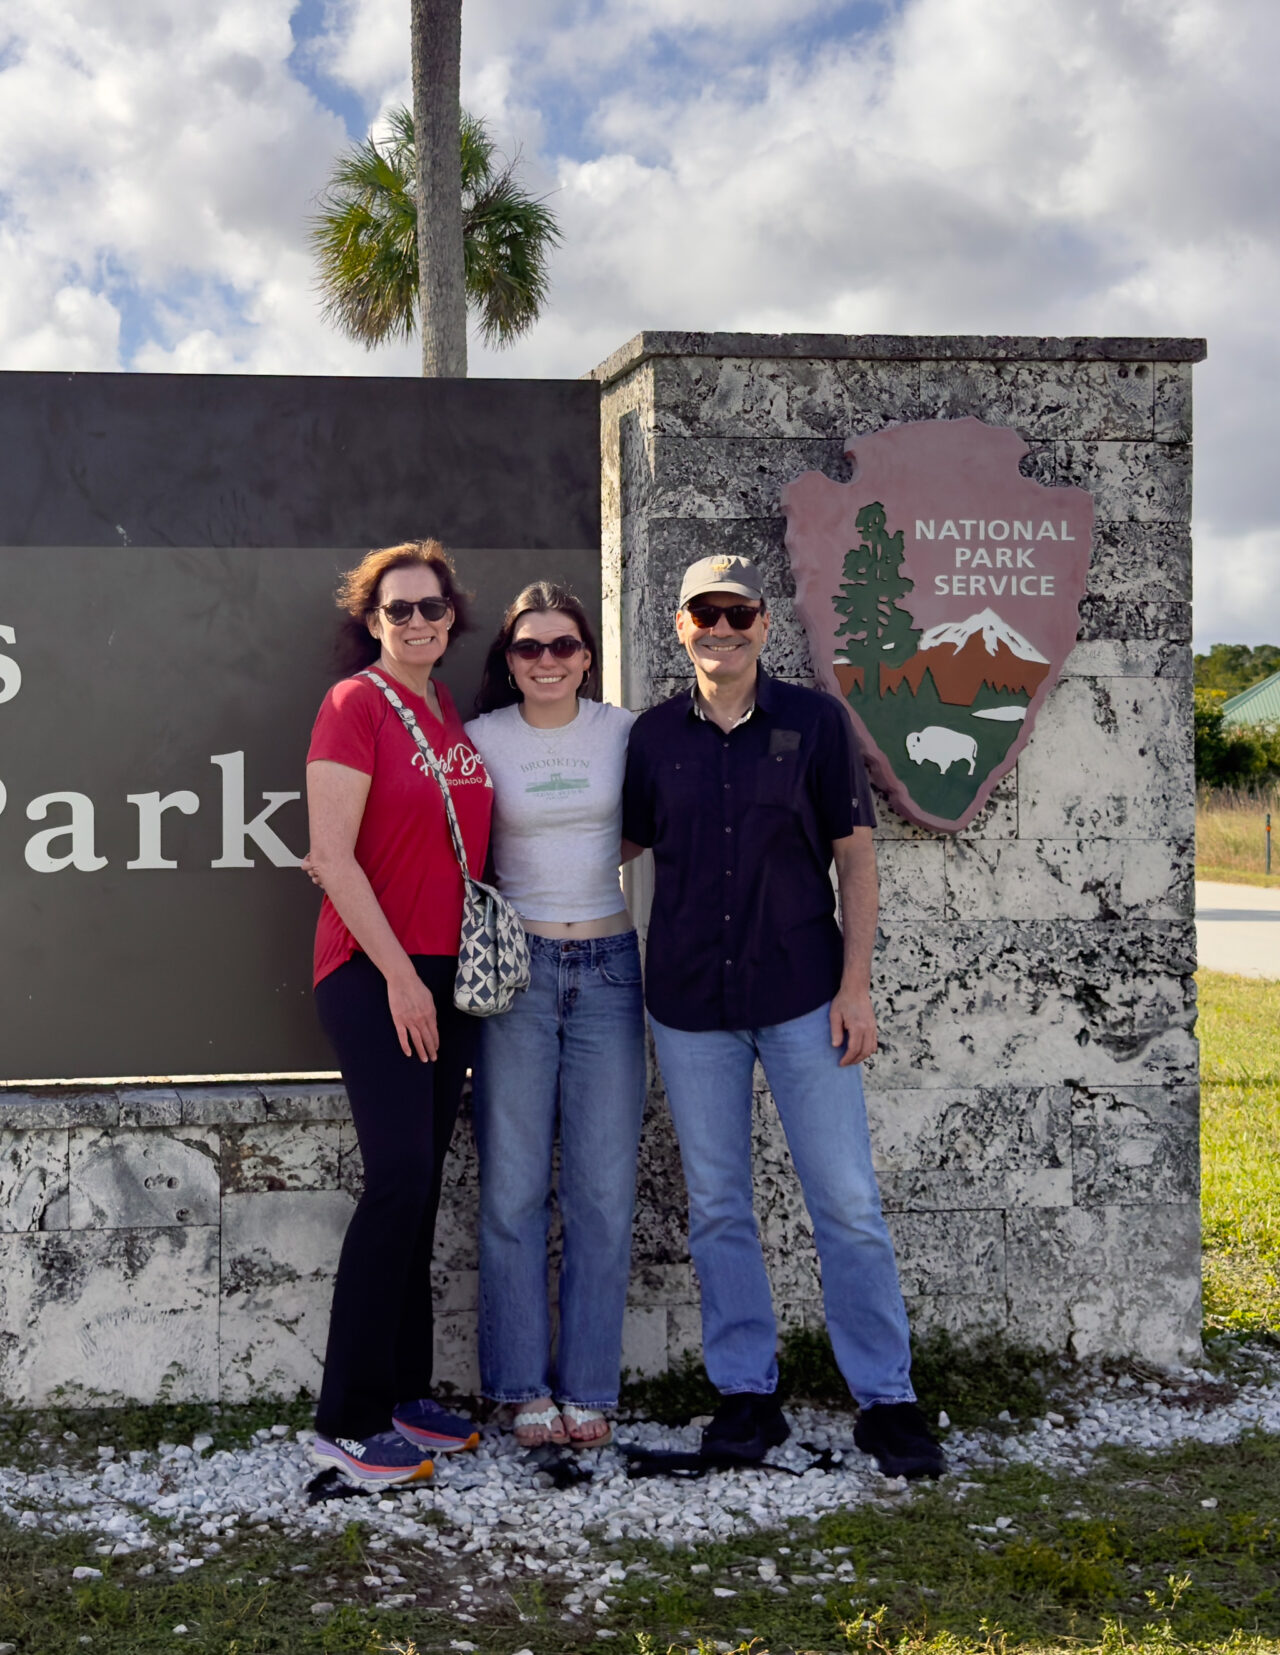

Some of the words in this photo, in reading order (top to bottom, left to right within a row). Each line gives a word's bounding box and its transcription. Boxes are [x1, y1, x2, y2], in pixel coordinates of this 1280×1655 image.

[915, 519, 1075, 541] NATIONAL
[955, 547, 1035, 568] PARK
[934, 575, 1055, 596] SERVICE
[411, 747, 454, 777] Htel
